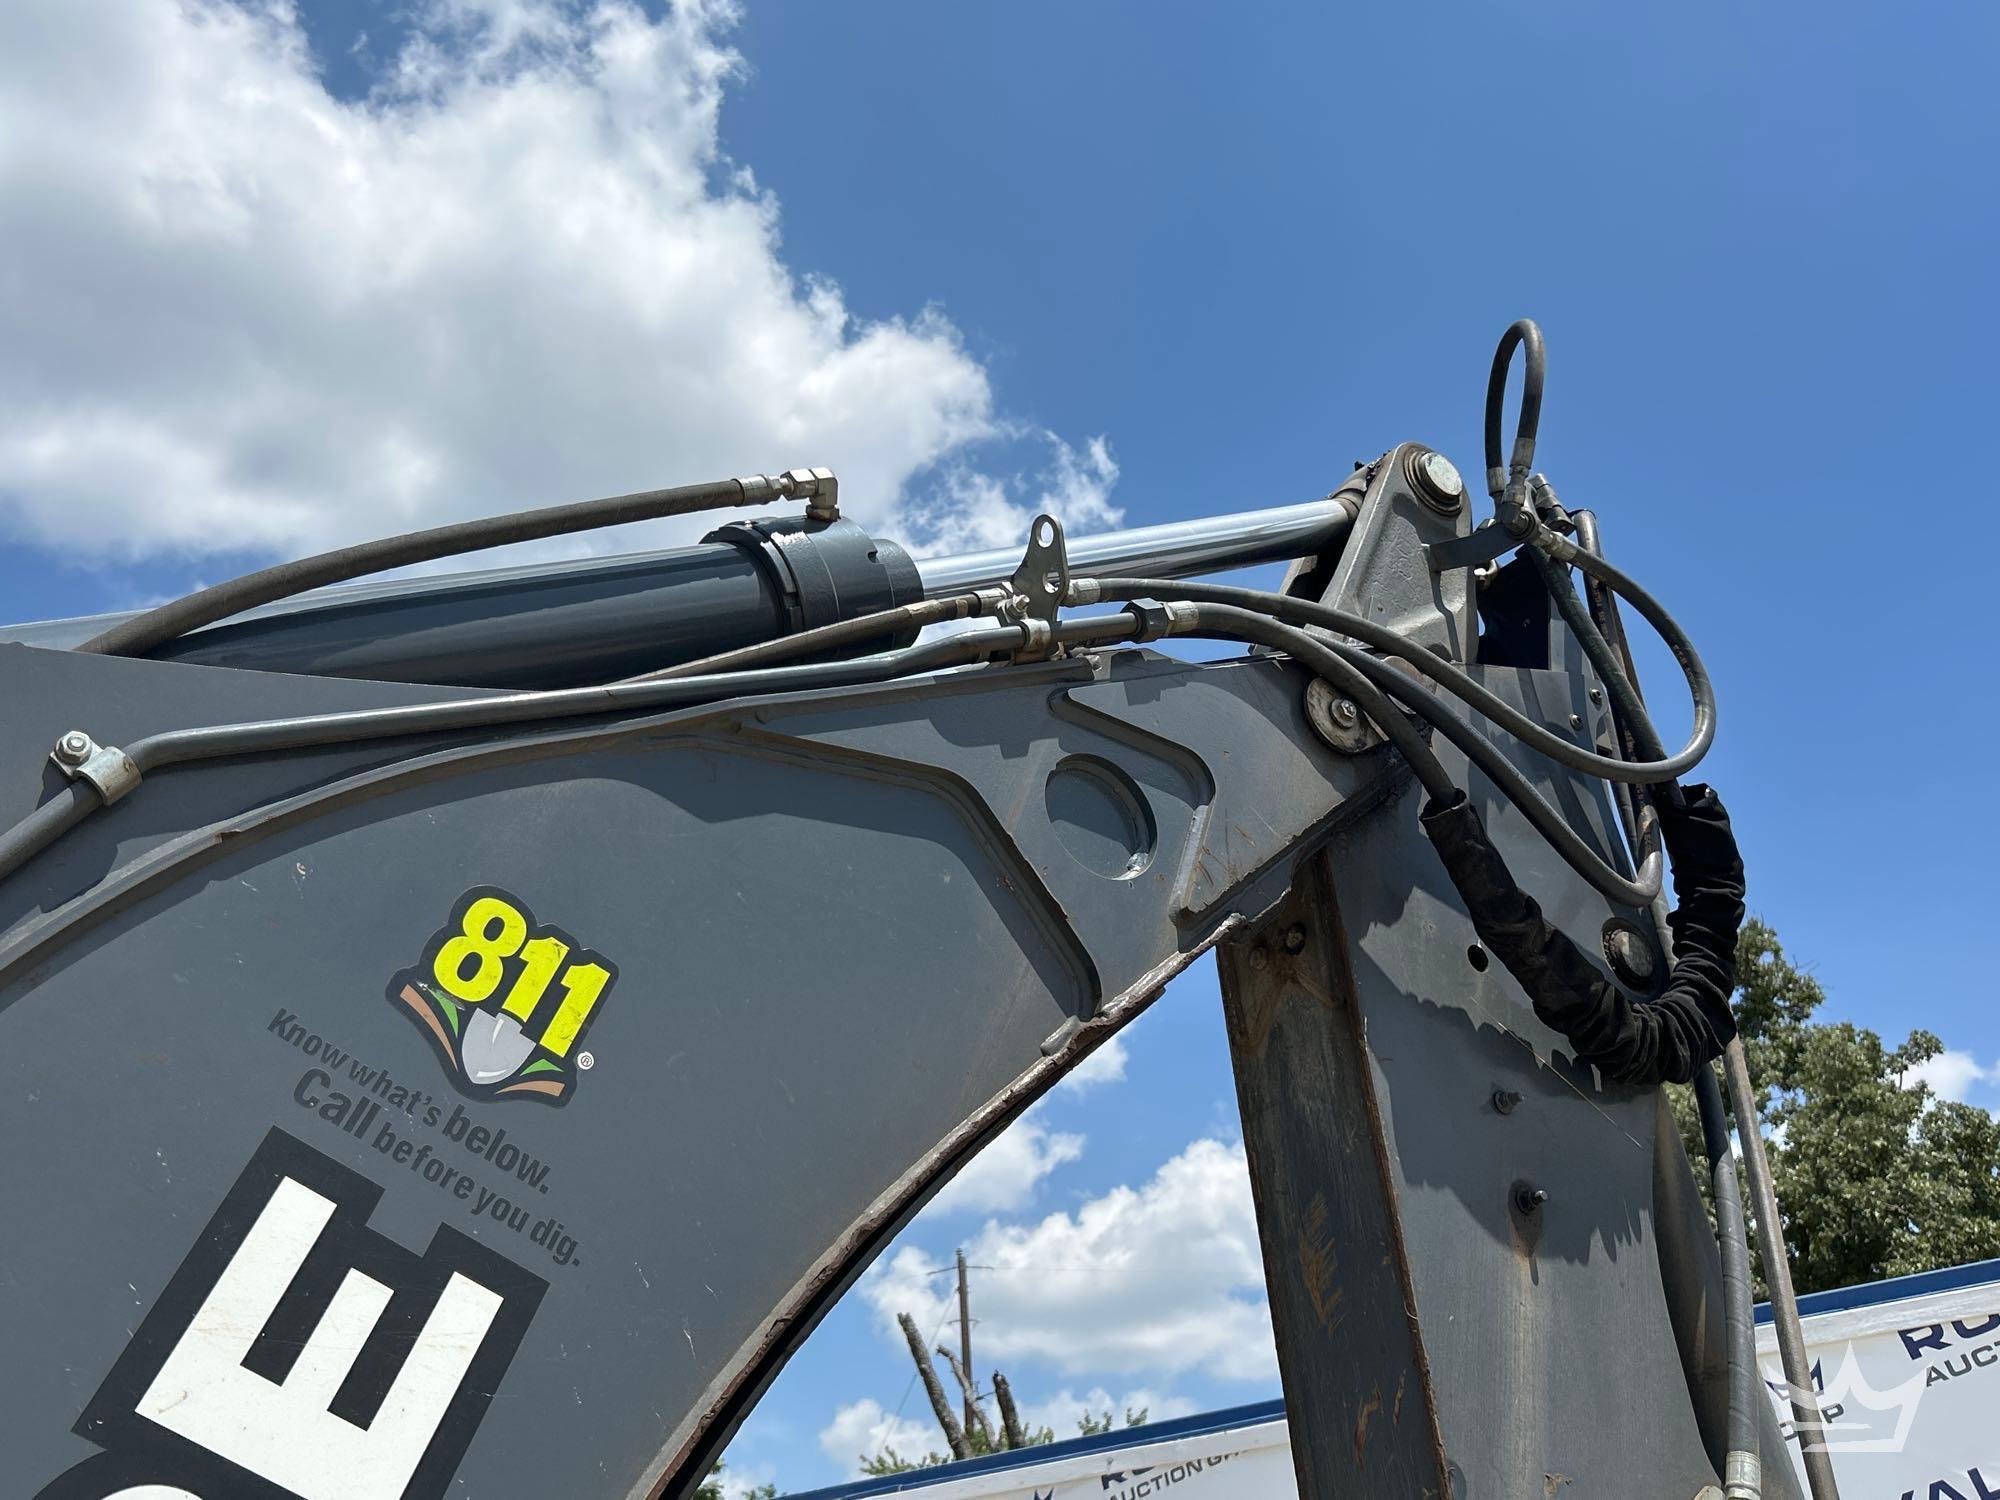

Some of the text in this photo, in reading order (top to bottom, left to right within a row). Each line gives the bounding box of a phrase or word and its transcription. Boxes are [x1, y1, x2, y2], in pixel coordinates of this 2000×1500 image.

[434, 897, 611, 1058] 811
[267, 1008, 552, 1194] Know what's below.
[293, 1068, 581, 1267] Call before you dig.
